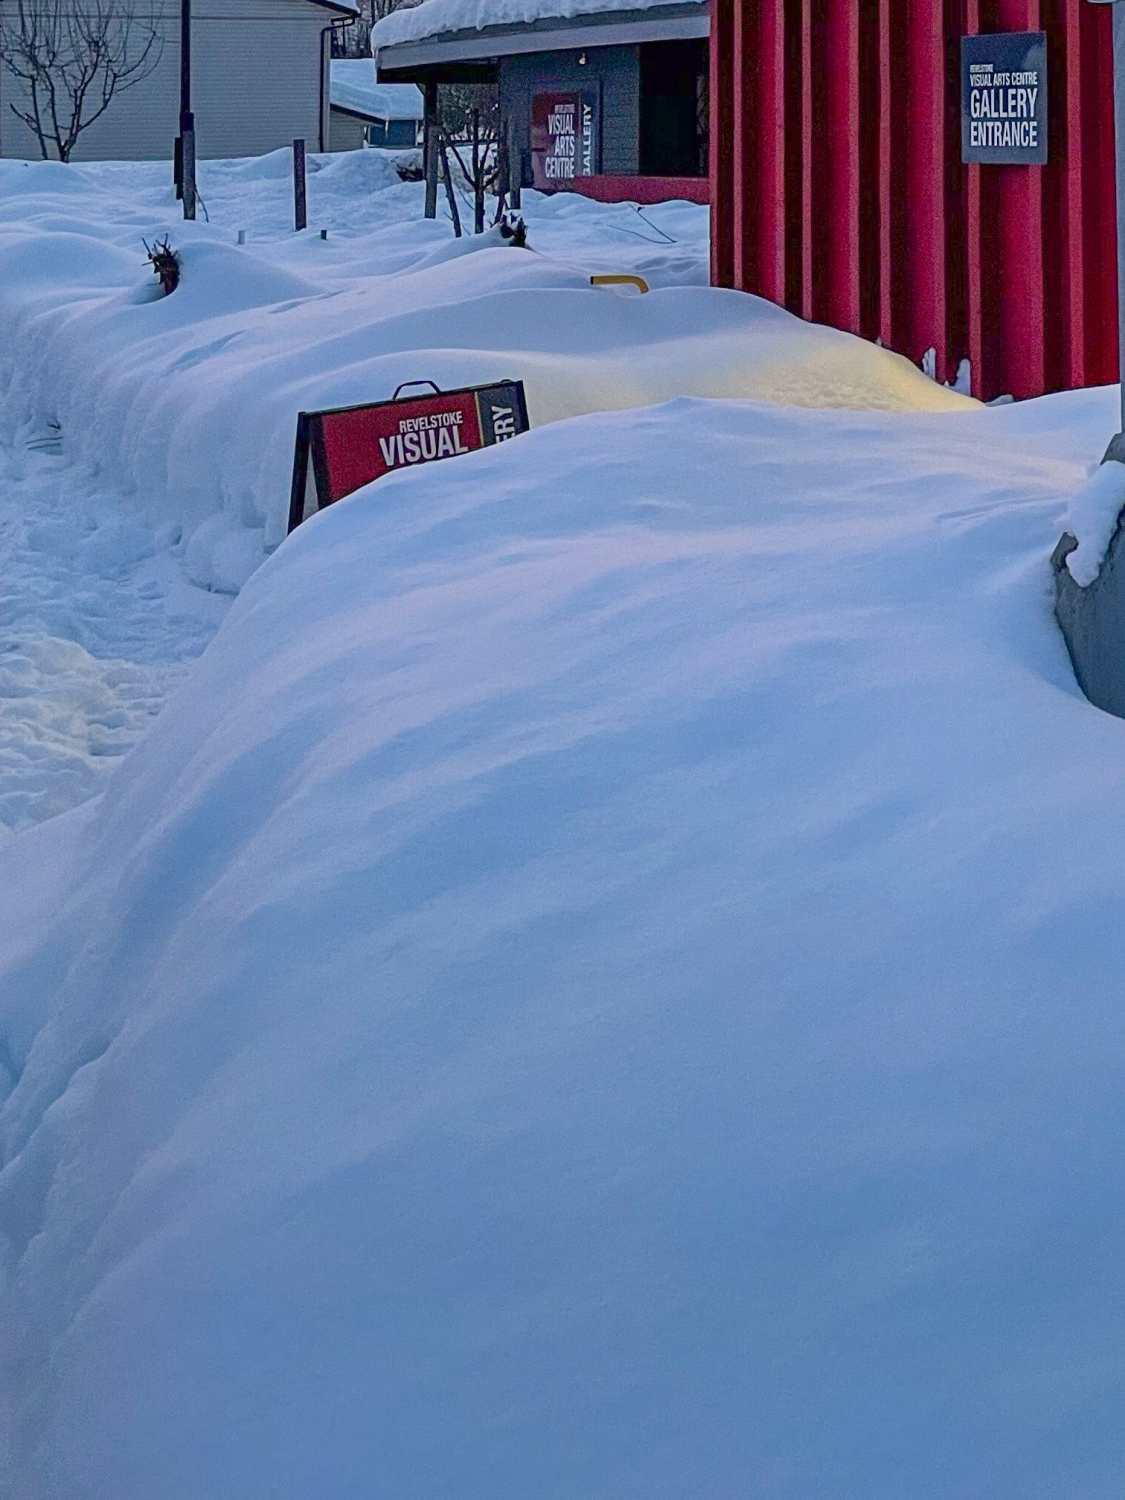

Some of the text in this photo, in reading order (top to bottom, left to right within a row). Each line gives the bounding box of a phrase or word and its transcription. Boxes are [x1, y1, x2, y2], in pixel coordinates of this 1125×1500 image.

[970, 71, 1038, 87] VISUAL ARTS CENTRE
[970, 88, 1038, 118] GALLERY
[548, 114, 575, 135] VISUAL
[970, 121, 1038, 147] ENTRANCE
[555, 136, 575, 156] ARTS
[546, 157, 575, 178] CENTRE
[399, 411, 463, 433] REVELSTOKE
[378, 425, 469, 467] VISUAL
